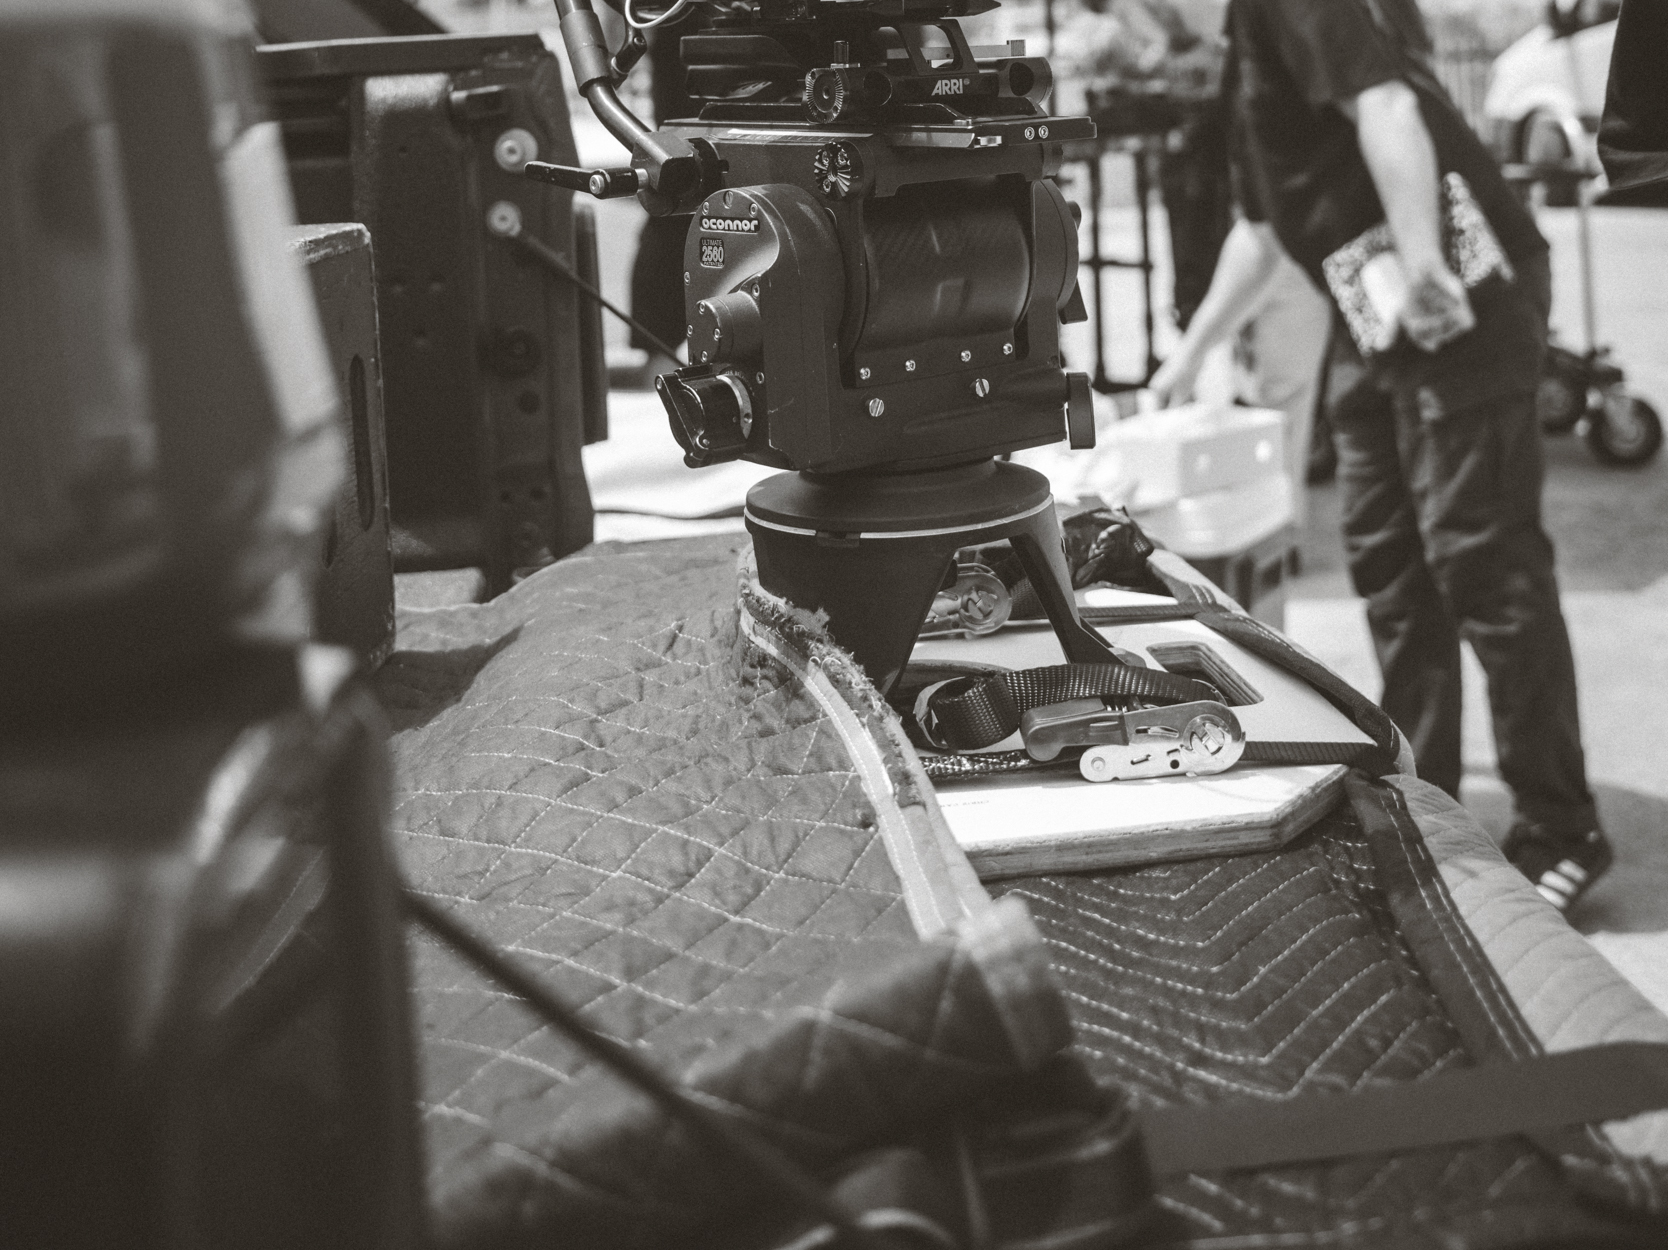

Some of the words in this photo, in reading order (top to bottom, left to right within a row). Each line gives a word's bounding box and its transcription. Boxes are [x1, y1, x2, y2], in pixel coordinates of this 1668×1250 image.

[931, 78, 963, 96] ARRI
[701, 239, 723, 247] ULTIMATE
[702, 246, 724, 262] 2560
